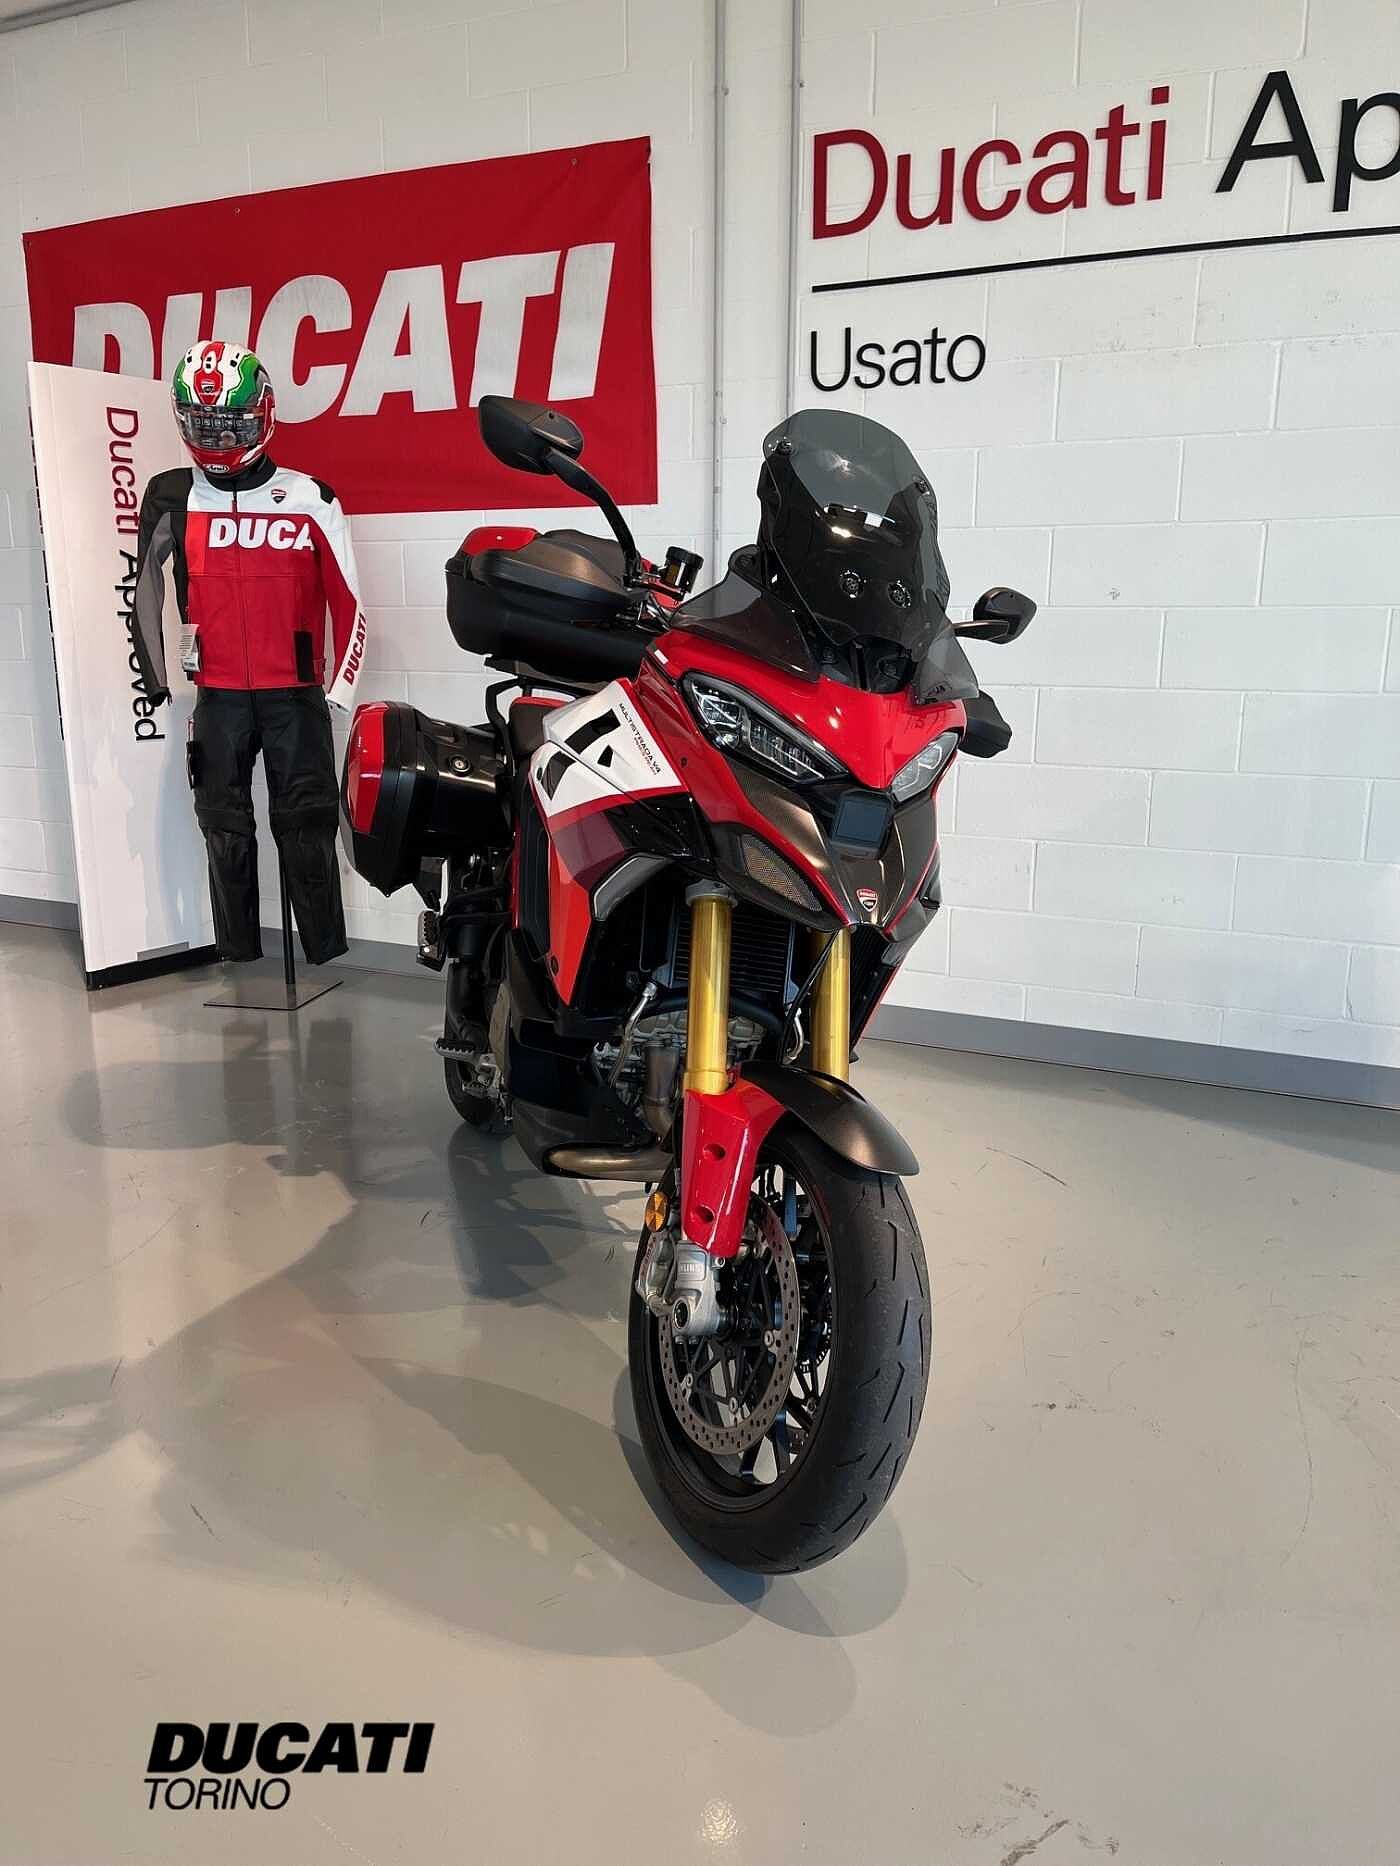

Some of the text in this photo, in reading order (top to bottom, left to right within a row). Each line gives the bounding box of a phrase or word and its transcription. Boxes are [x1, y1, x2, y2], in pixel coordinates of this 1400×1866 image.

[811, 70, 1400, 240] Ducati Ap
[810, 327, 987, 392] Usato
[106, 407, 140, 535] Ducati
[208, 518, 315, 551] DUCA
[342, 611, 367, 686] DUCATI
